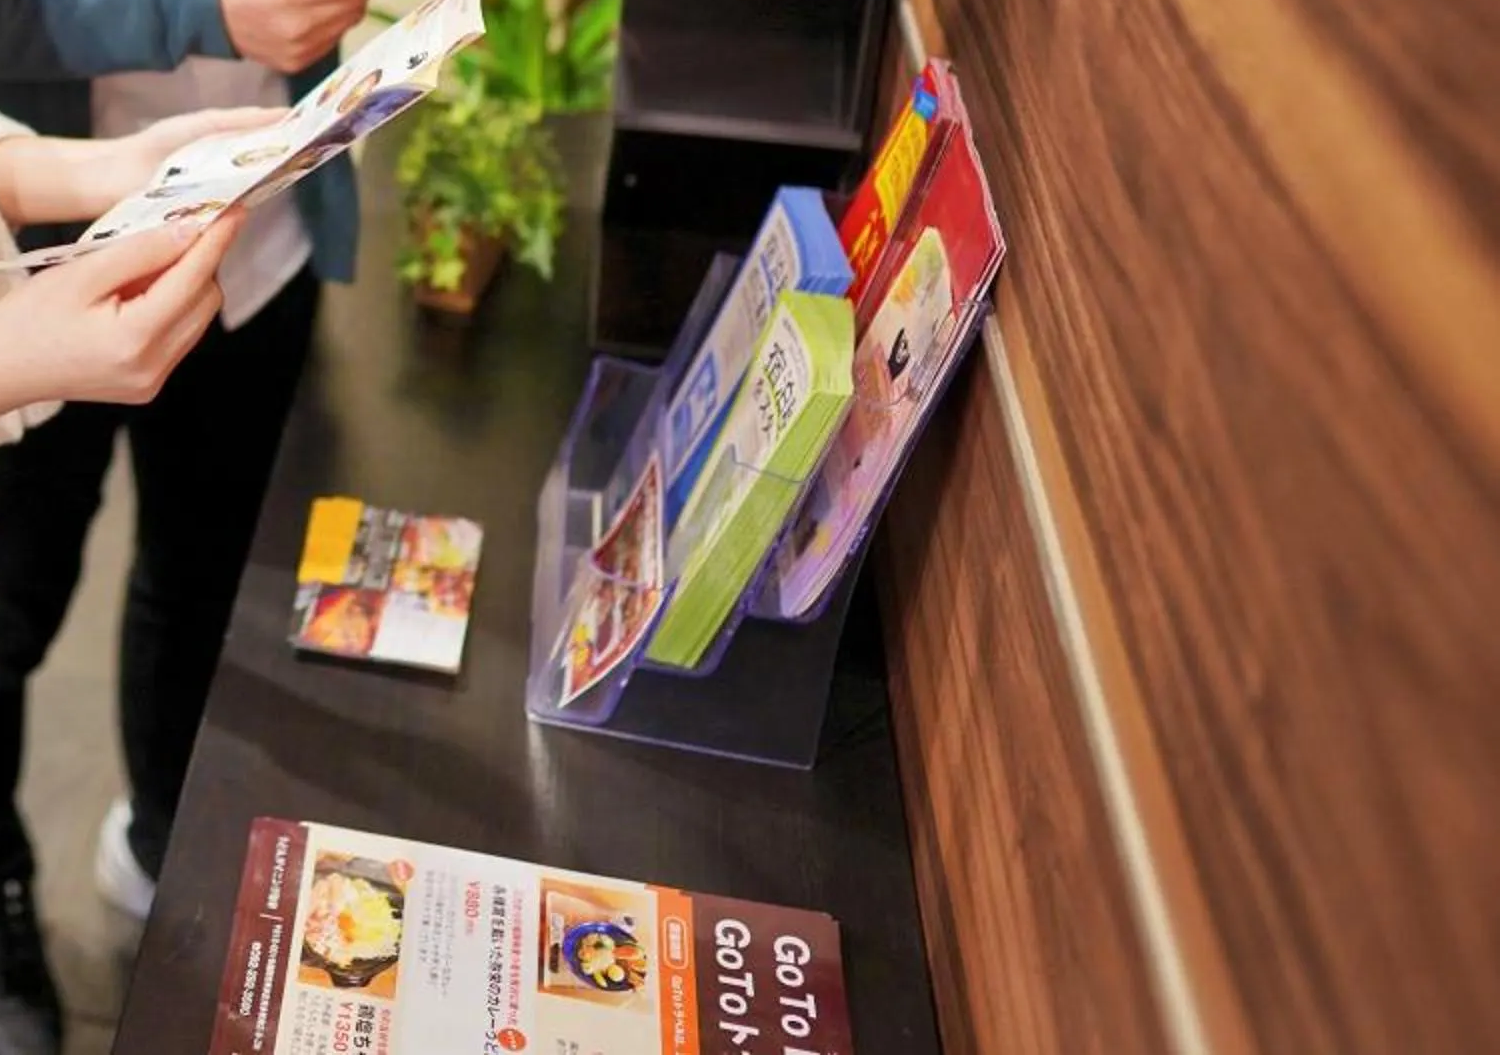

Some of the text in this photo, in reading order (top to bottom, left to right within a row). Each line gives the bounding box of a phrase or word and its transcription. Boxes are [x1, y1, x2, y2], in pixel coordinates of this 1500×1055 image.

[715, 919, 760, 1055] GoToト
[773, 935, 811, 988] Go
[333, 1002, 353, 1052] ¥1350
[779, 993, 817, 1038] To
